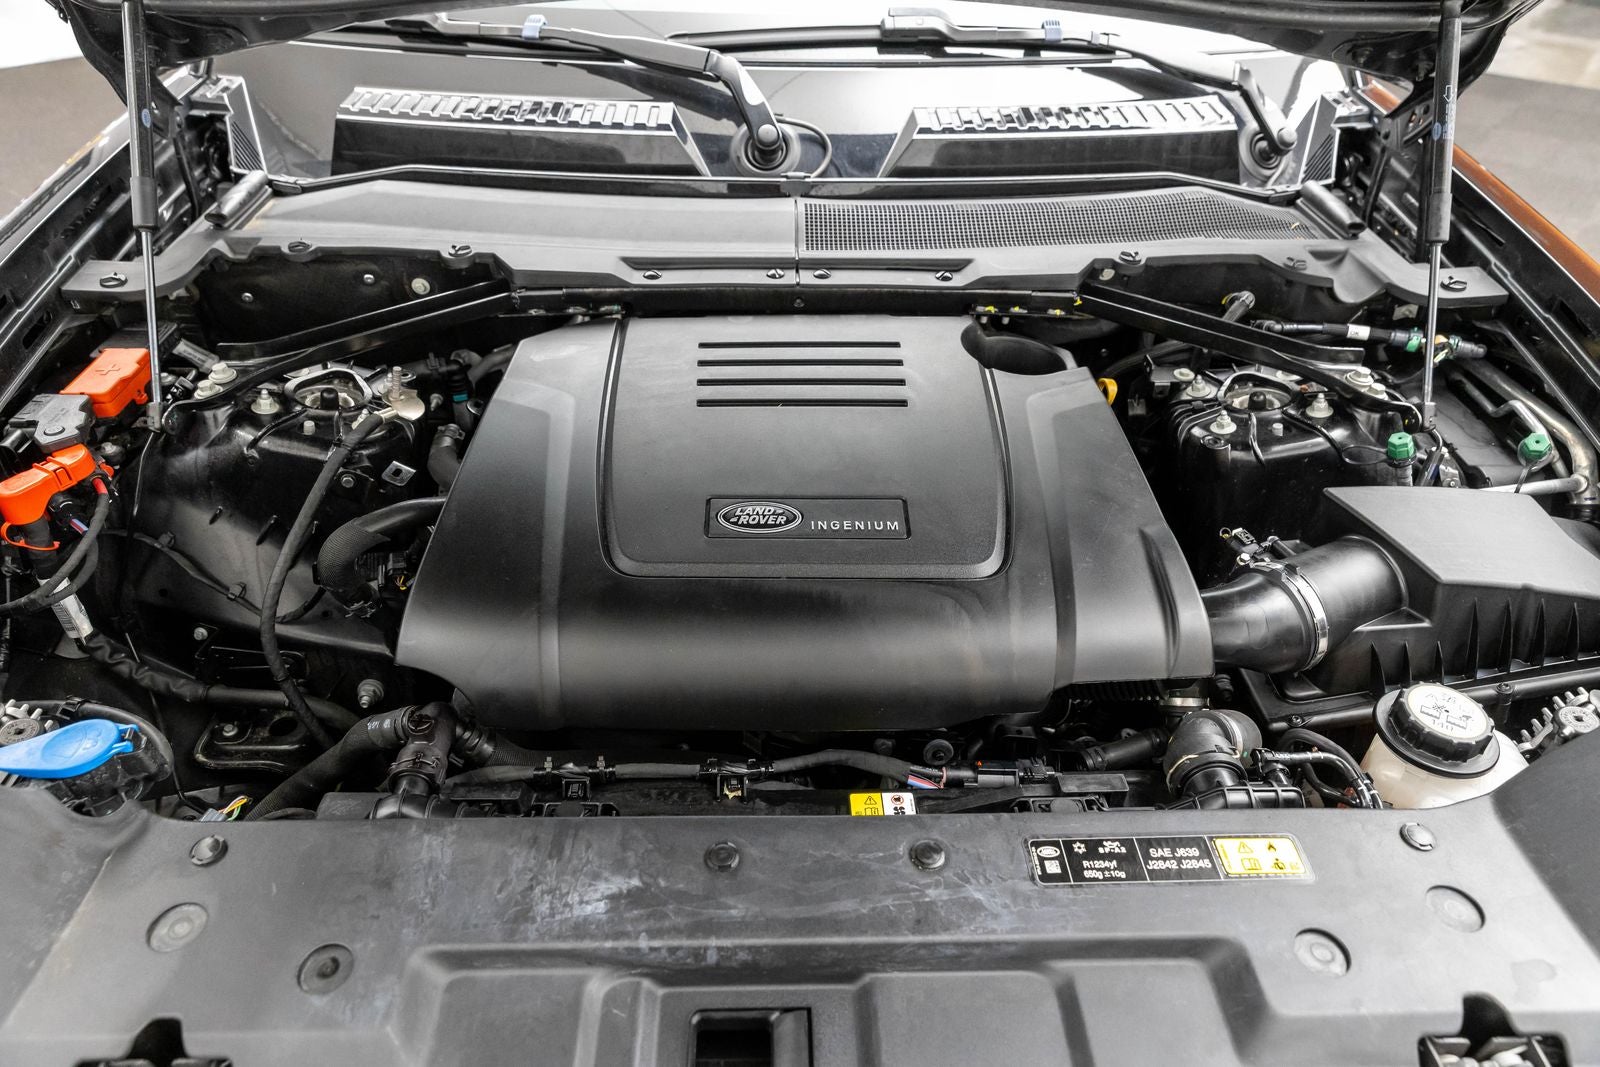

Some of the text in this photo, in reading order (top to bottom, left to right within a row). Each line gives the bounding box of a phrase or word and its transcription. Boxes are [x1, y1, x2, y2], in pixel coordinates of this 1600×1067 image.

[735, 505, 775, 516] LAND
[737, 515, 787, 525] ROVER
[811, 520, 899, 531] INGENIUM
[1149, 847, 1200, 857] SAE J639
[1082, 860, 1118, 869] R1234yf
[1146, 858, 1212, 869] J2842 J2845
[1083, 870, 1104, 880] 650g
